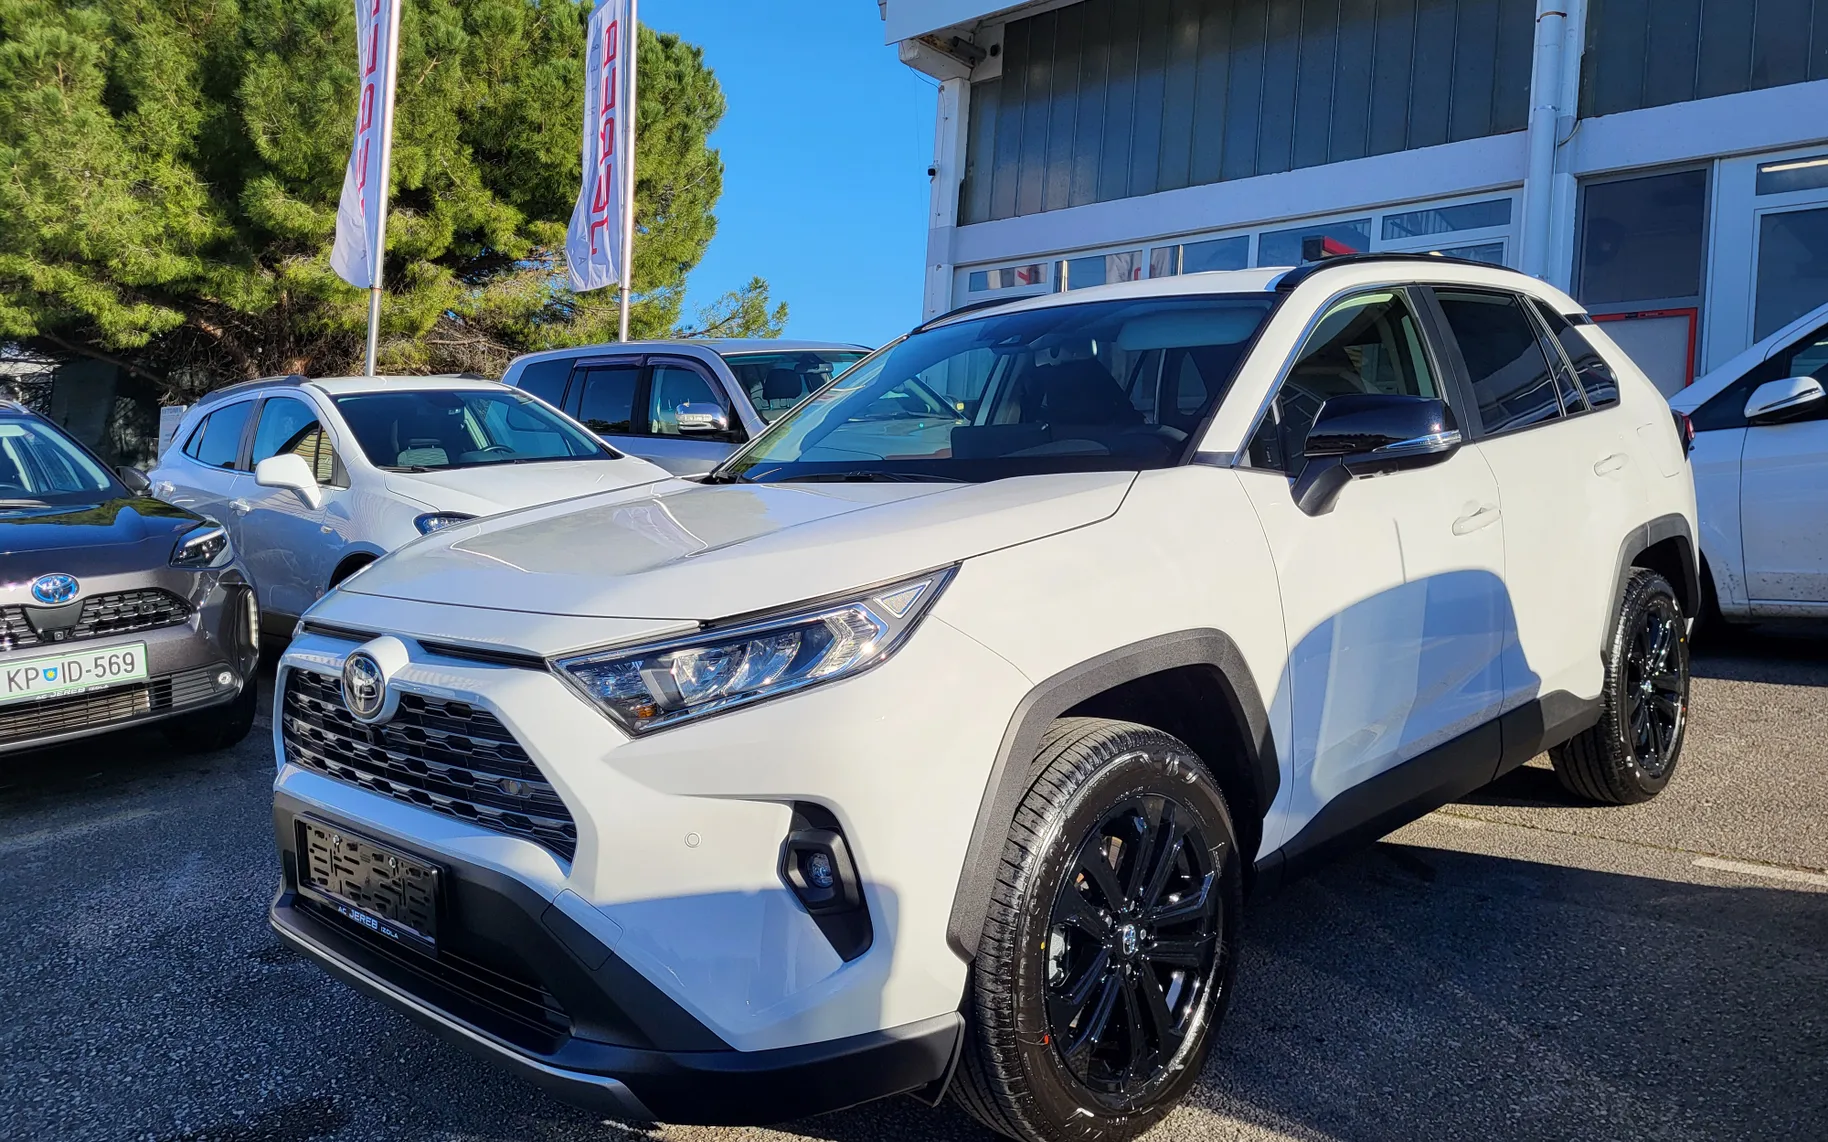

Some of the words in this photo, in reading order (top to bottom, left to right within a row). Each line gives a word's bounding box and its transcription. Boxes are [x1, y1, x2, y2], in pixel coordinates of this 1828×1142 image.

[6, 666, 40, 693] KP
[61, 651, 136, 684] ID-569
[50, 687, 86, 698] JEREB
[338, 906, 347, 915] AC
[348, 909, 378, 930] JEREB
[380, 926, 399, 940] IZOLA
